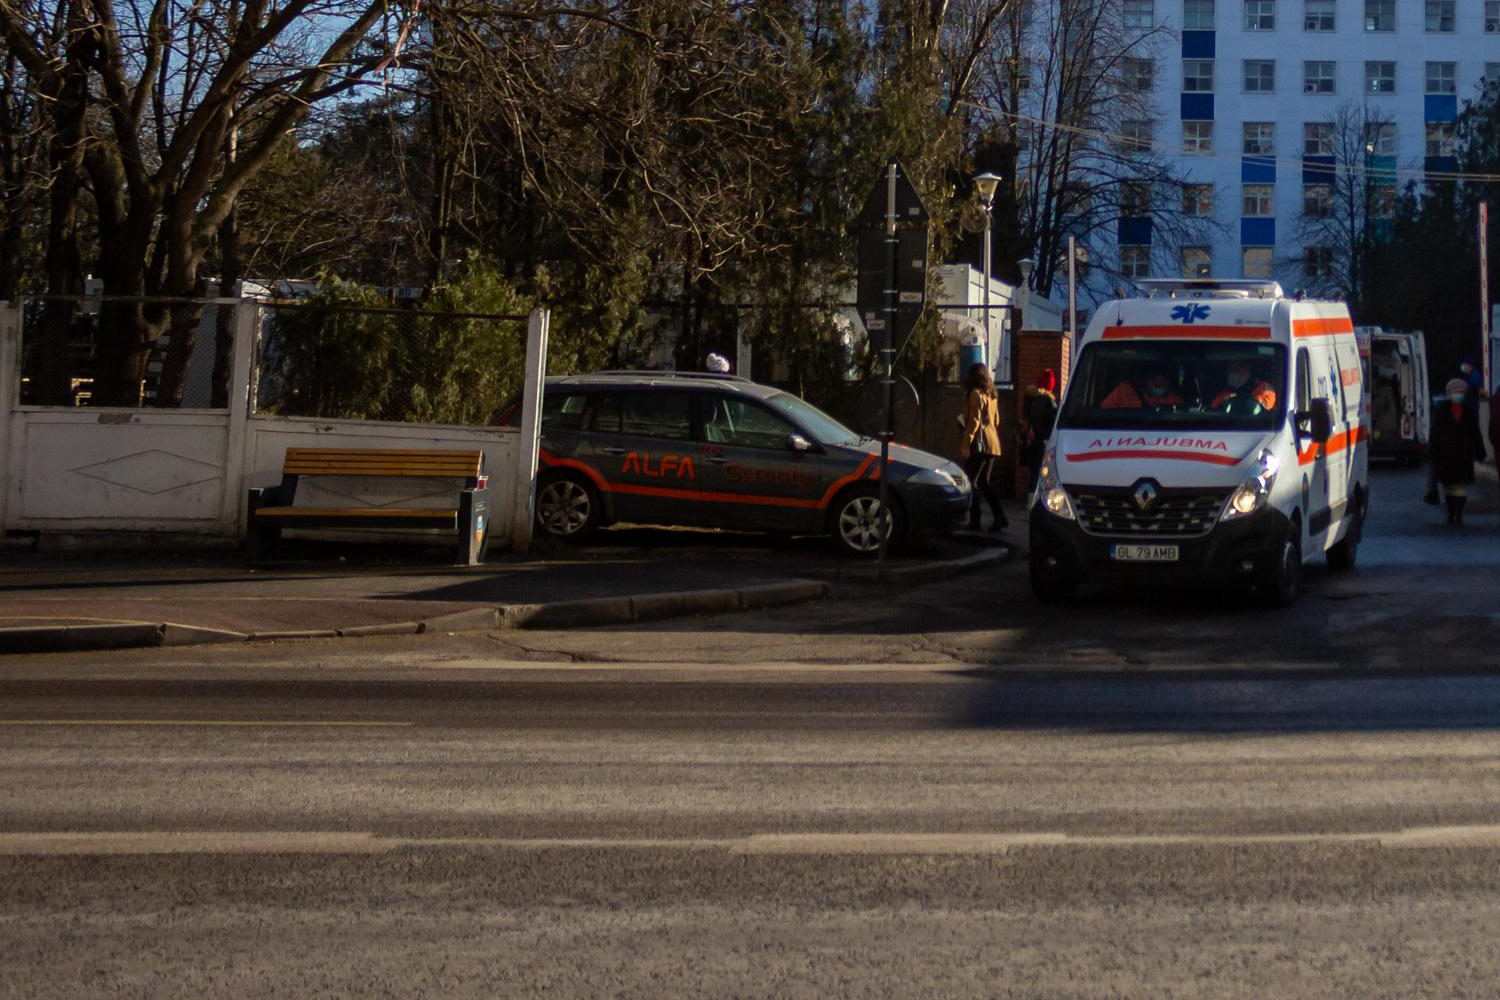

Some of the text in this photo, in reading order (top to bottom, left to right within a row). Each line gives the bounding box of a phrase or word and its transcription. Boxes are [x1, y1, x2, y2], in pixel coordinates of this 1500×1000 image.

[622, 450, 698, 480] ALFA
[1117, 547, 1133, 559] GL
[1137, 547, 1151, 558] 79
